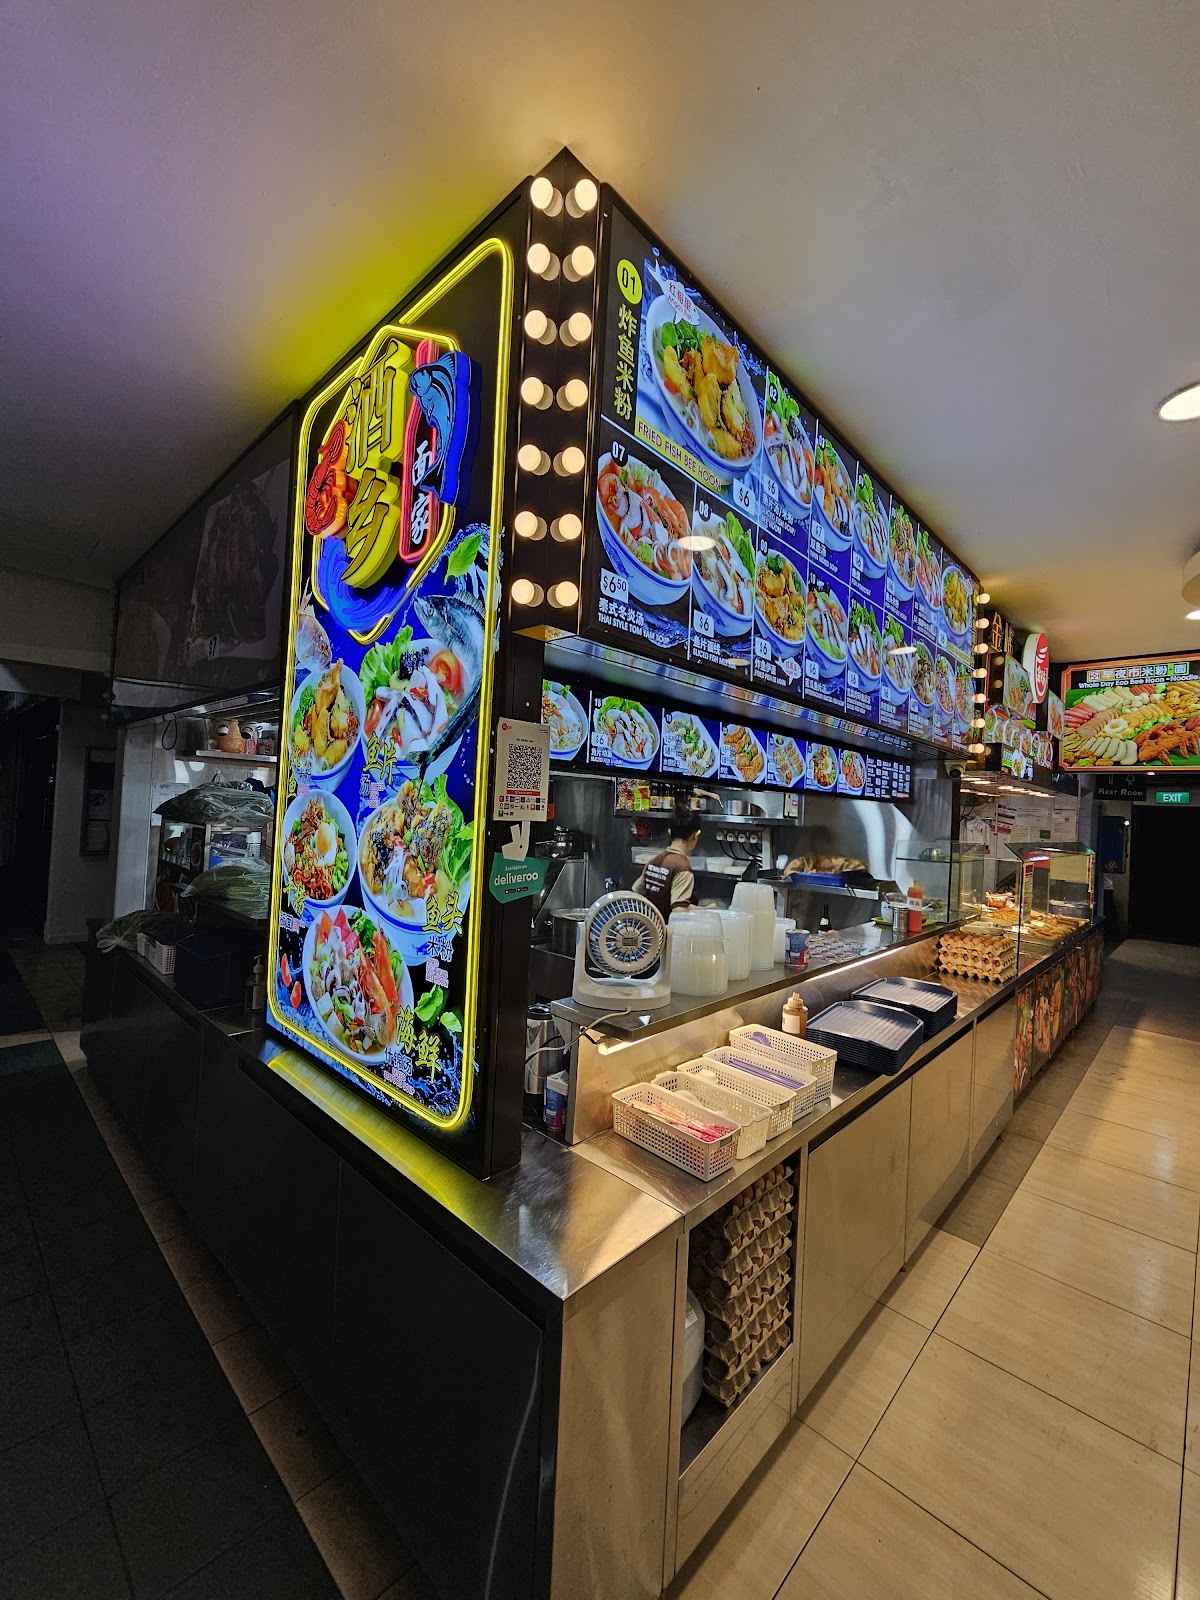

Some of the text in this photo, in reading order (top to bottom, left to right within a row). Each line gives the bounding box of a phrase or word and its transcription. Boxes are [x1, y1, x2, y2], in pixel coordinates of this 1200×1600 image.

[621, 267, 637, 296] 01
[613, 302, 638, 421] 炸鱼米粉
[769, 385, 778, 400] 02
[612, 441, 625, 462] 07
[638, 420, 722, 491] FRIED FISH BEE HOON
[411, 440, 433, 545] 面家
[738, 486, 751, 509] $6
[768, 480, 776, 495] $6
[700, 501, 710, 517] 08
[598, 597, 645, 627] 泰式冬炎汤
[700, 615, 710, 631] $6
[598, 612, 670, 644] THAI STYLE TOM YAM SOUP
[692, 647, 709, 660] SLICED
[709, 654, 719, 664] FISH
[760, 642, 768, 656] $6
[595, 734, 605, 745] $6
[362, 730, 398, 786] 鱼片
[1162, 793, 1183, 802] EXIT
[494, 871, 539, 887] deliveroo
[421, 890, 464, 937] 鱼头
[427, 935, 455, 962] 米粉
[395, 1005, 442, 1084] 海鲜
